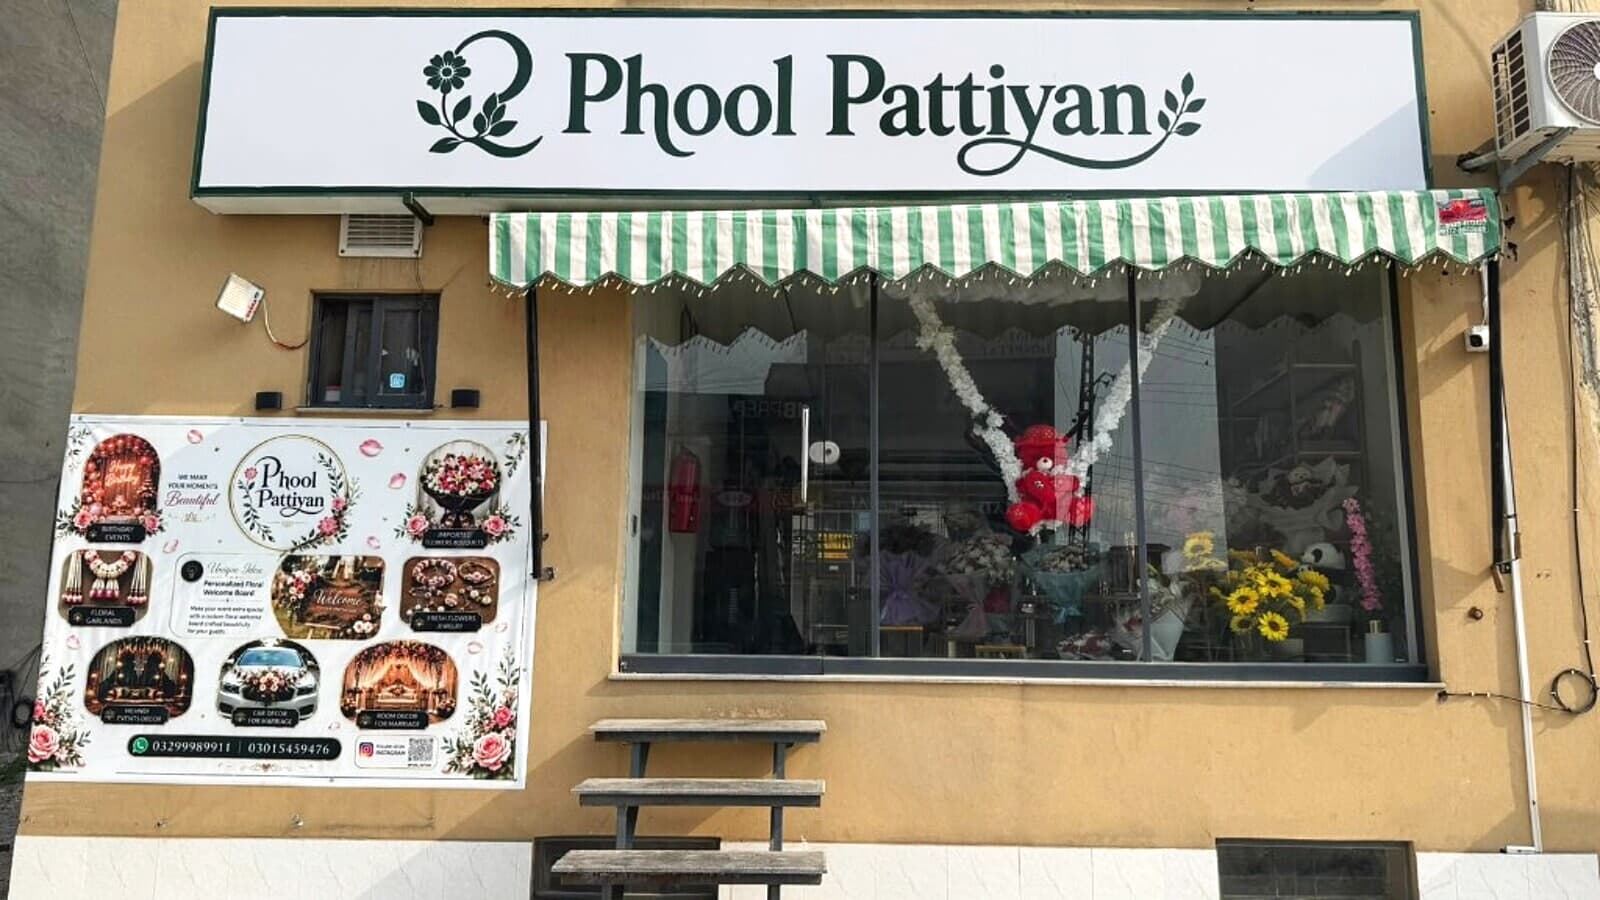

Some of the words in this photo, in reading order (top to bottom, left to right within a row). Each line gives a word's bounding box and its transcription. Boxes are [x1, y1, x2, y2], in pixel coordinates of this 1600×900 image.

[561, 53, 797, 157] Phool
[826, 54, 1160, 176] Pattiyan
[255, 456, 316, 490] Phool
[165, 490, 221, 510] Beautiful
[255, 489, 325, 517] Pattiyan
[313, 589, 361, 605] Welcome
[152, 740, 231, 753] 03299989911
[247, 742, 330, 755] 03015459476
